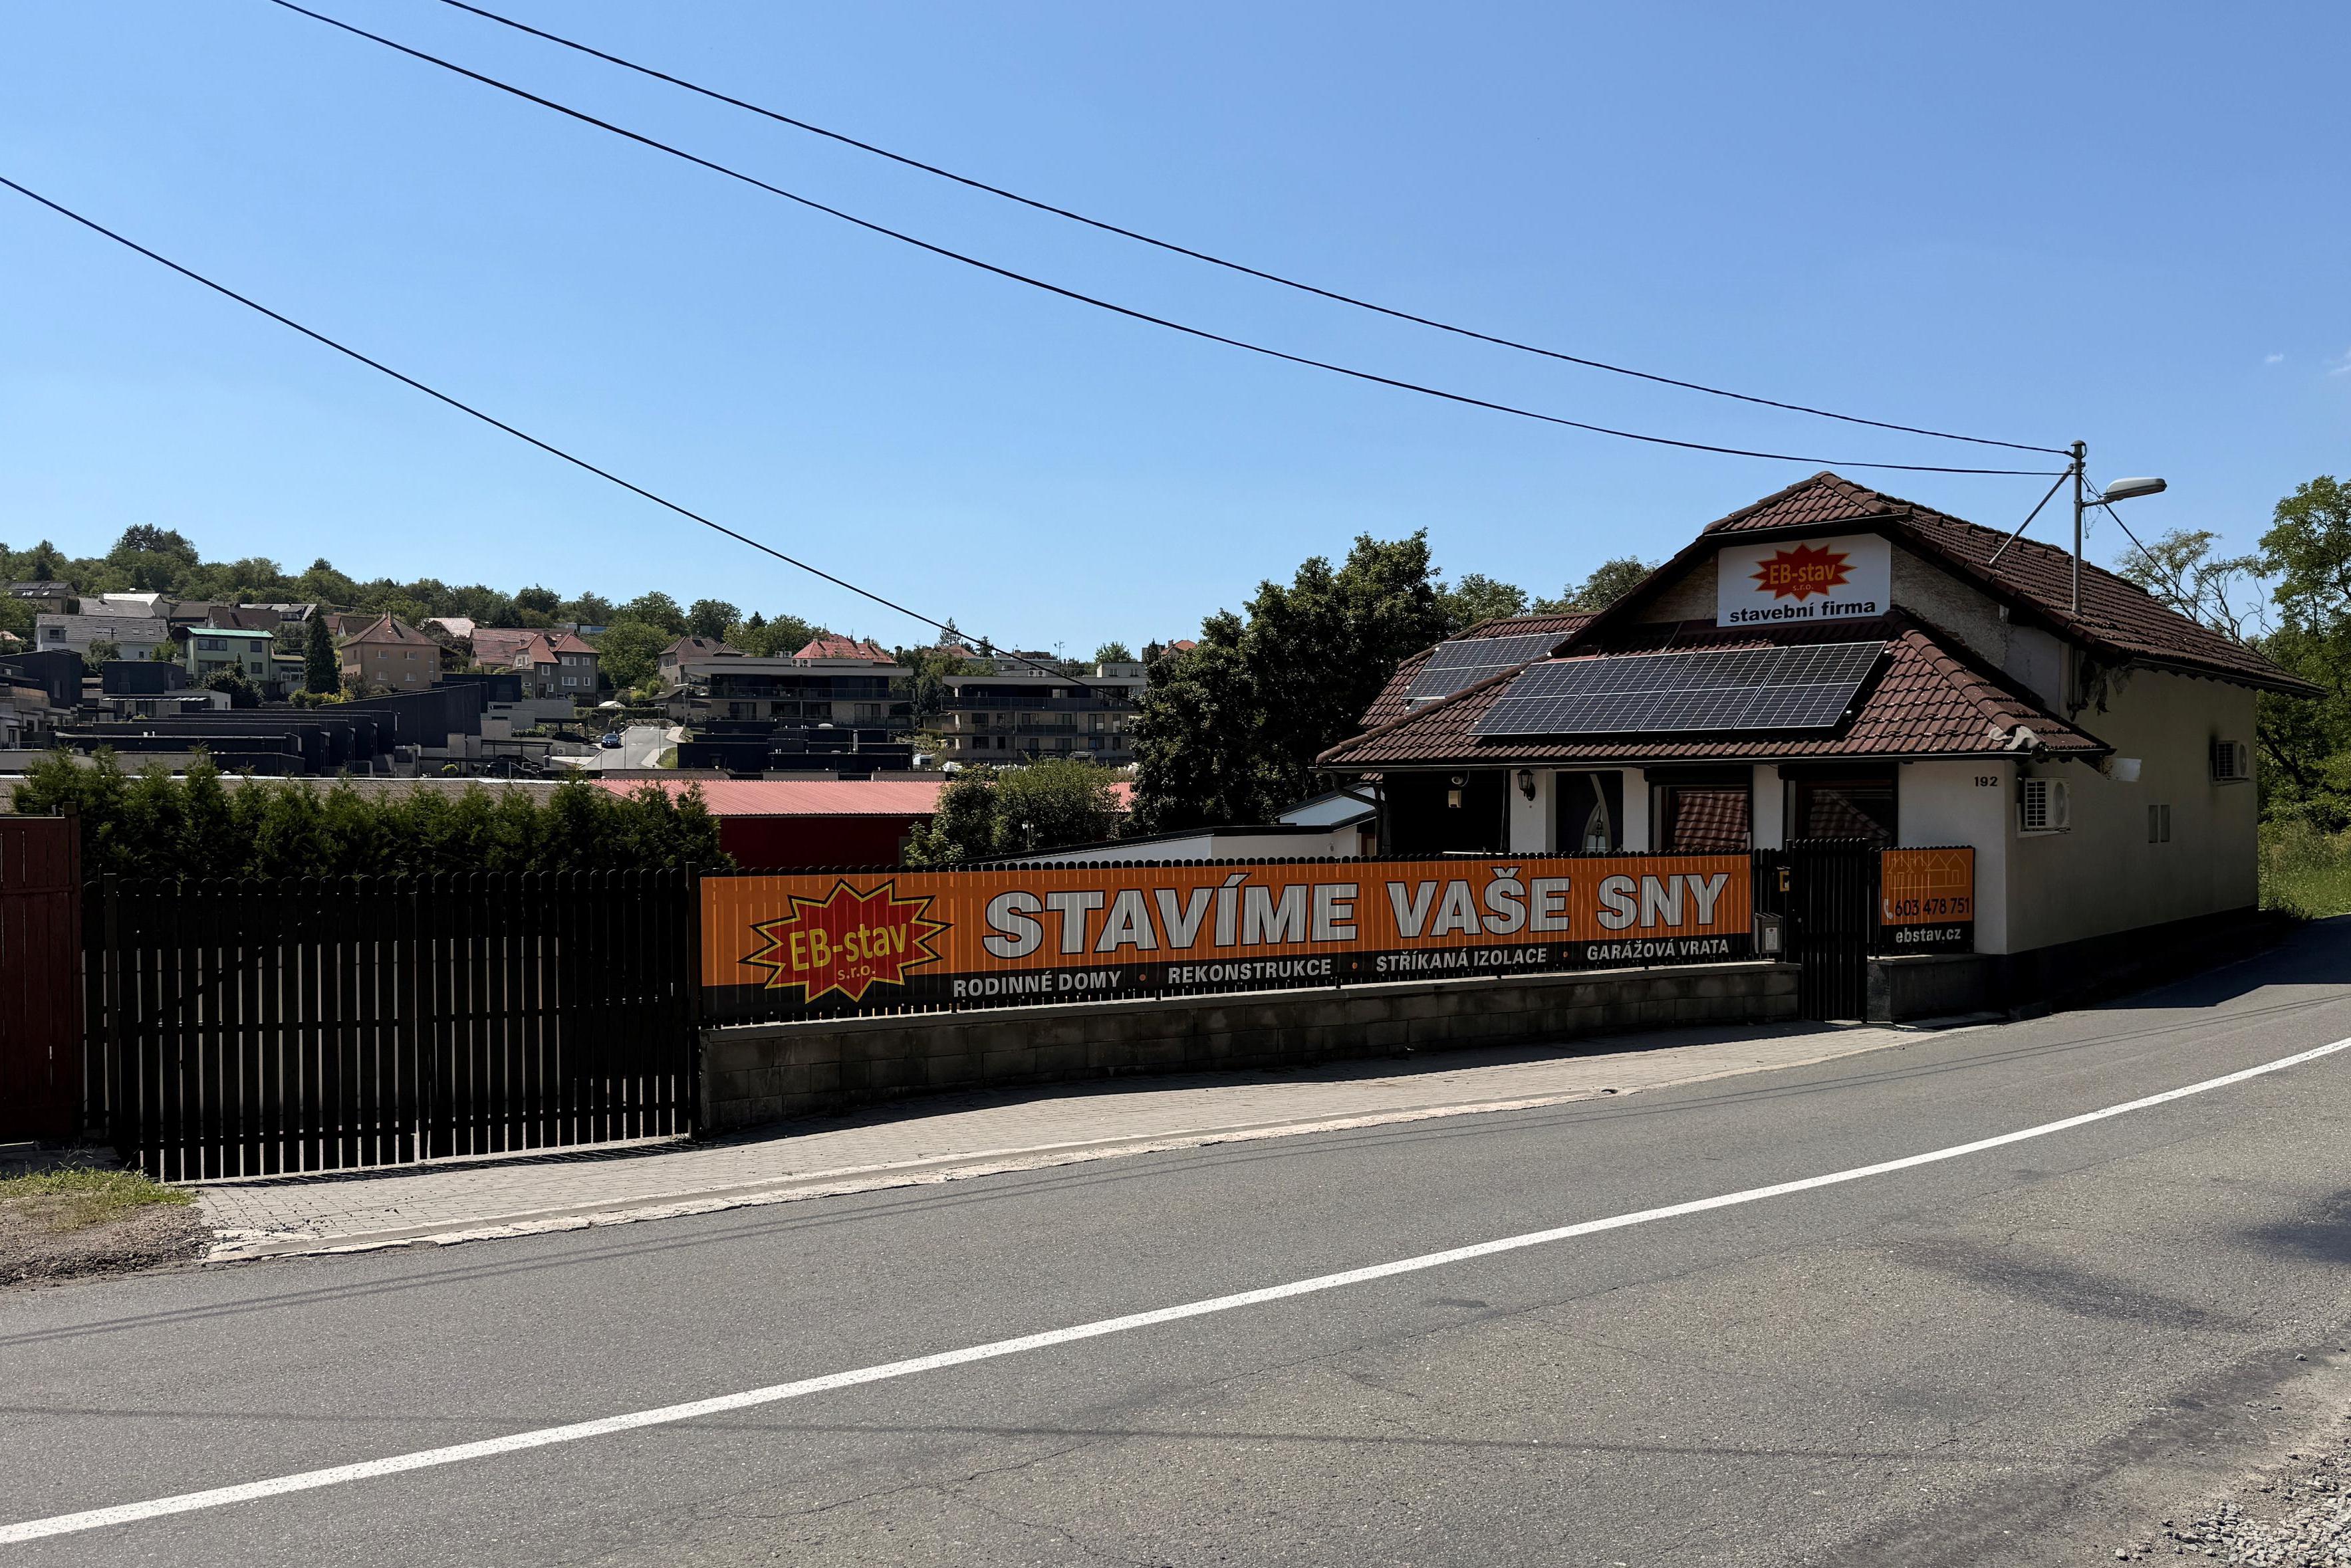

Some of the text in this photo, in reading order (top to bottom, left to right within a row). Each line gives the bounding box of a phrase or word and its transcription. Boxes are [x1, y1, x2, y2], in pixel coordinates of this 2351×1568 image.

[1769, 562, 1836, 585] EB-stav
[1729, 601, 1876, 623] stavební firma
[1974, 776, 1998, 787] 192
[982, 866, 1732, 959] STAVÍME VAŠE SNY
[1895, 897, 1970, 917] 603 478 751
[1896, 927, 1961, 944] ebstav.cz
[789, 923, 907, 972] EB-stav
[837, 965, 876, 982] s.r.o.
[953, 938, 1729, 998] RODINNÉ DOMY REKONSTRUKCE STŘÍKANÁ IZOLACE GARÁŽOVÁ VRATA
